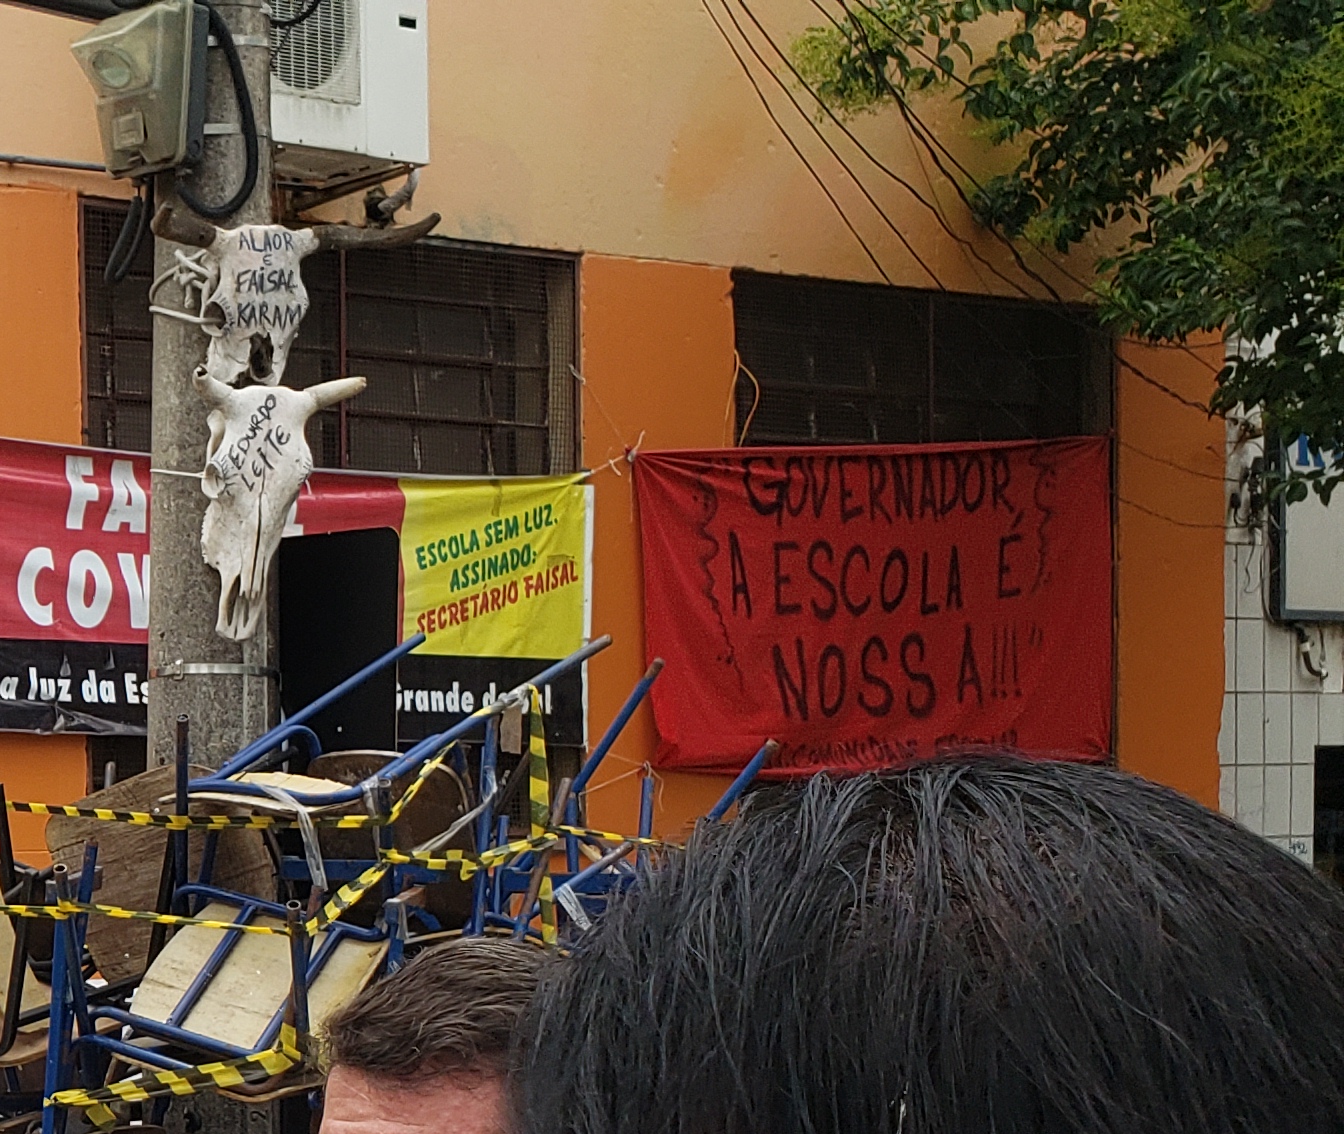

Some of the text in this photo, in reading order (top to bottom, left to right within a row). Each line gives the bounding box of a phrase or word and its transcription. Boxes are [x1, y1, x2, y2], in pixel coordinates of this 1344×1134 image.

[239, 229, 294, 252] ALAOR
[262, 254, 273, 266] E
[237, 301, 301, 331] KARAM
[228, 393, 277, 470] EDUARDO
[241, 425, 291, 492] LEITE
[415, 503, 558, 570] ESCOLA SEM LUZ.
[728, 509, 1026, 622] A ESCOLA É
[449, 543, 537, 592] ASSINADO:
[417, 559, 579, 636] SECRETÁRIO FAISAL
[0, 674, 19, 700] a
[27, 667, 72, 703] luz
[81, 669, 116, 704] da
